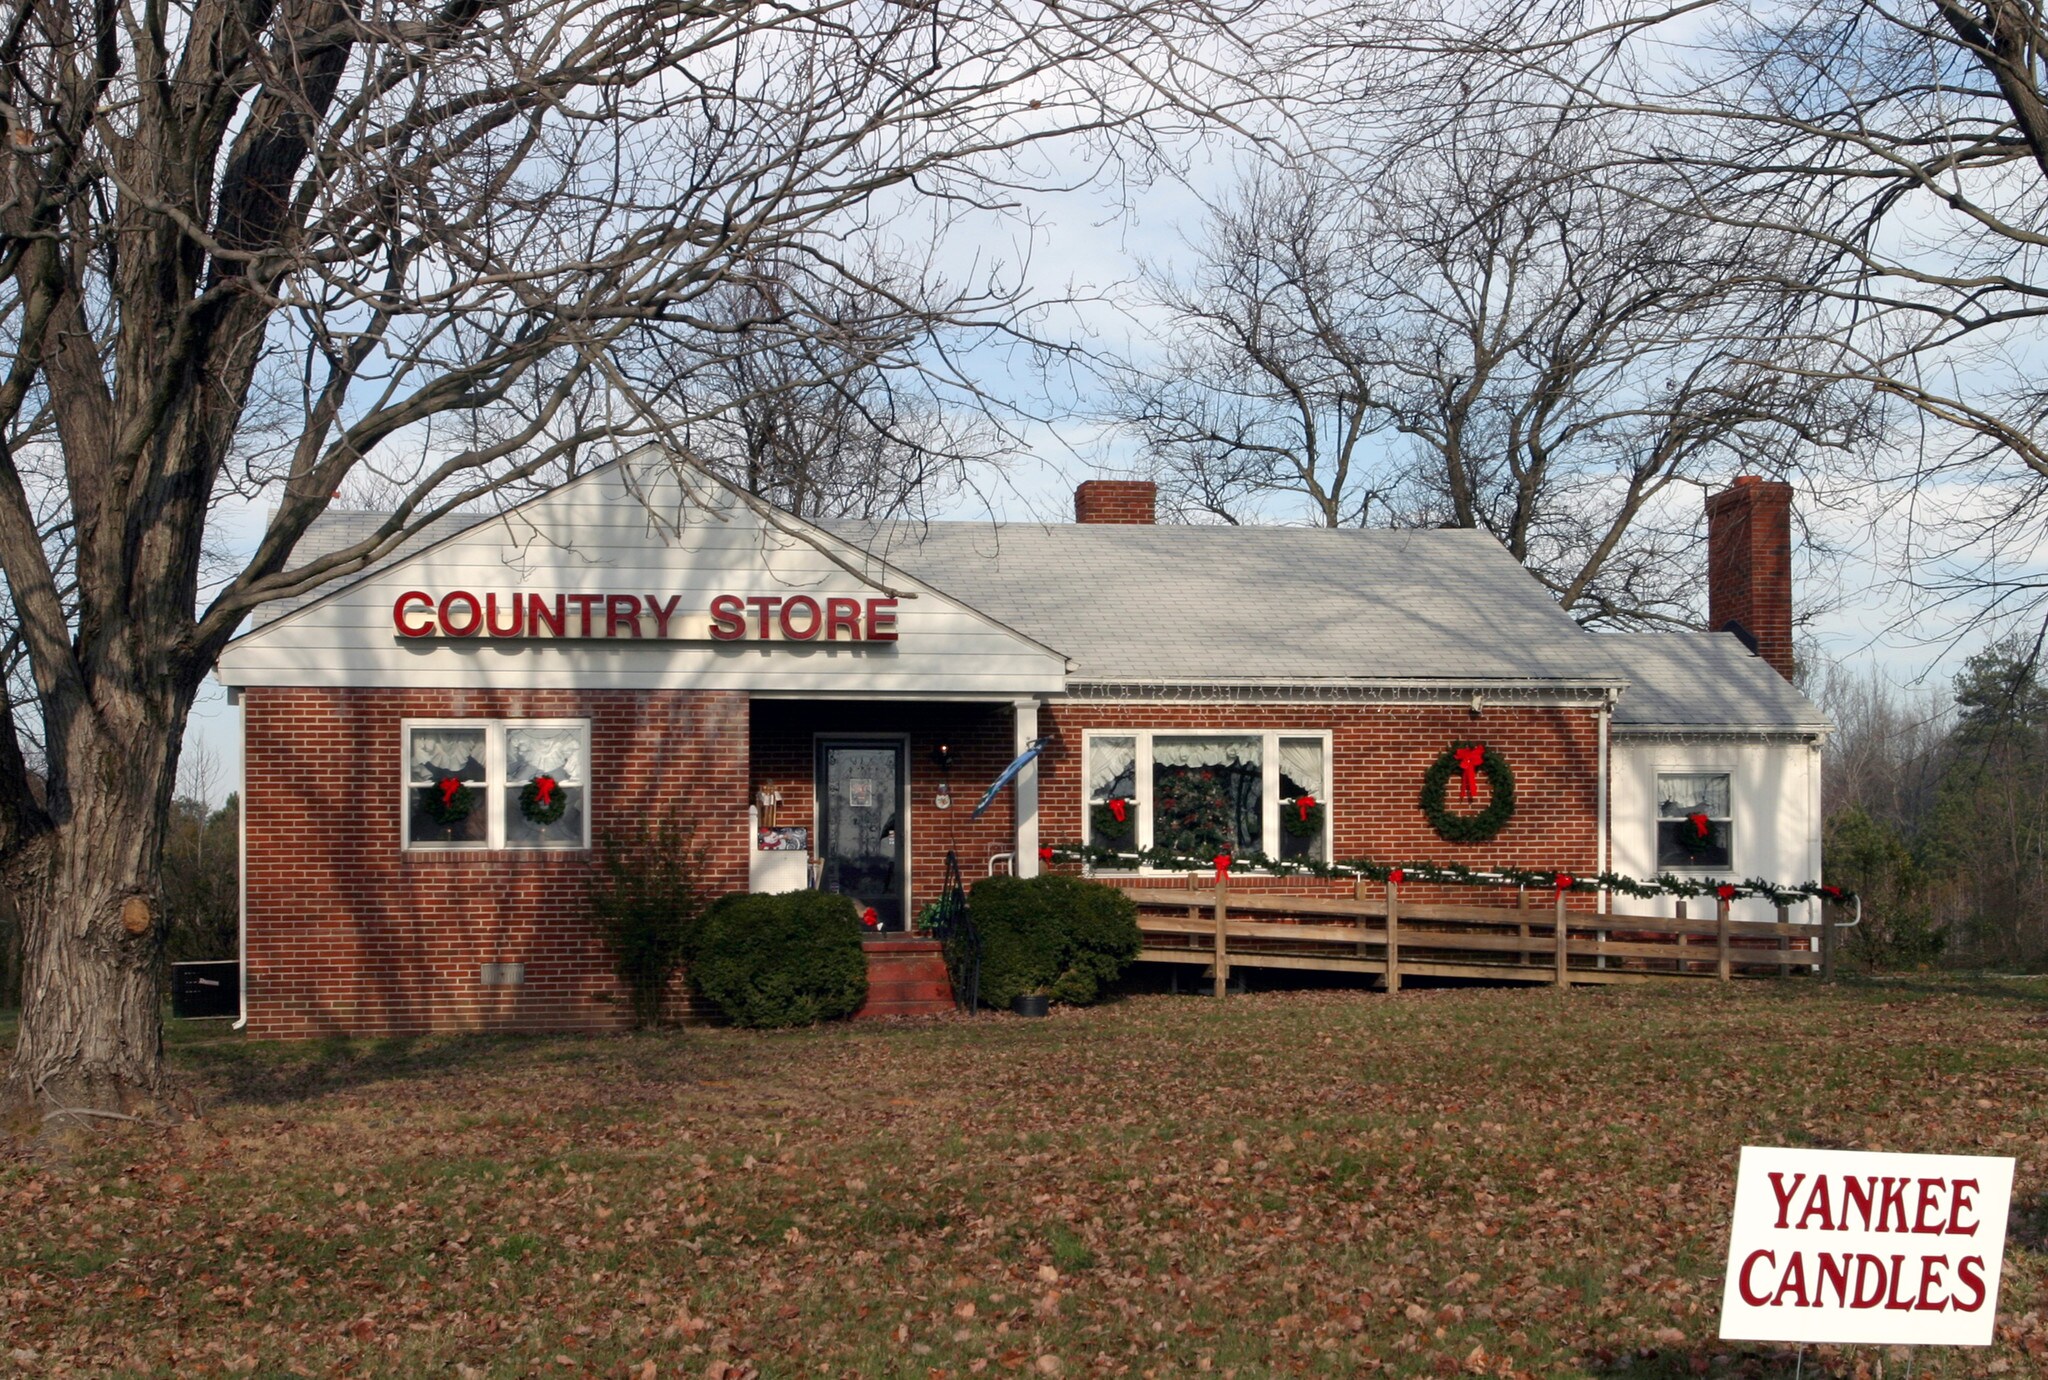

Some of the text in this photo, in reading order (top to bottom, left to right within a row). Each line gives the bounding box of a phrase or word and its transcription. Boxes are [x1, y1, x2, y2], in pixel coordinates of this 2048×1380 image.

[393, 590, 899, 642] COUNTRY STORE
[1767, 1172, 1980, 1237] YANKEE
[1738, 1249, 1986, 1313] CANDLES
